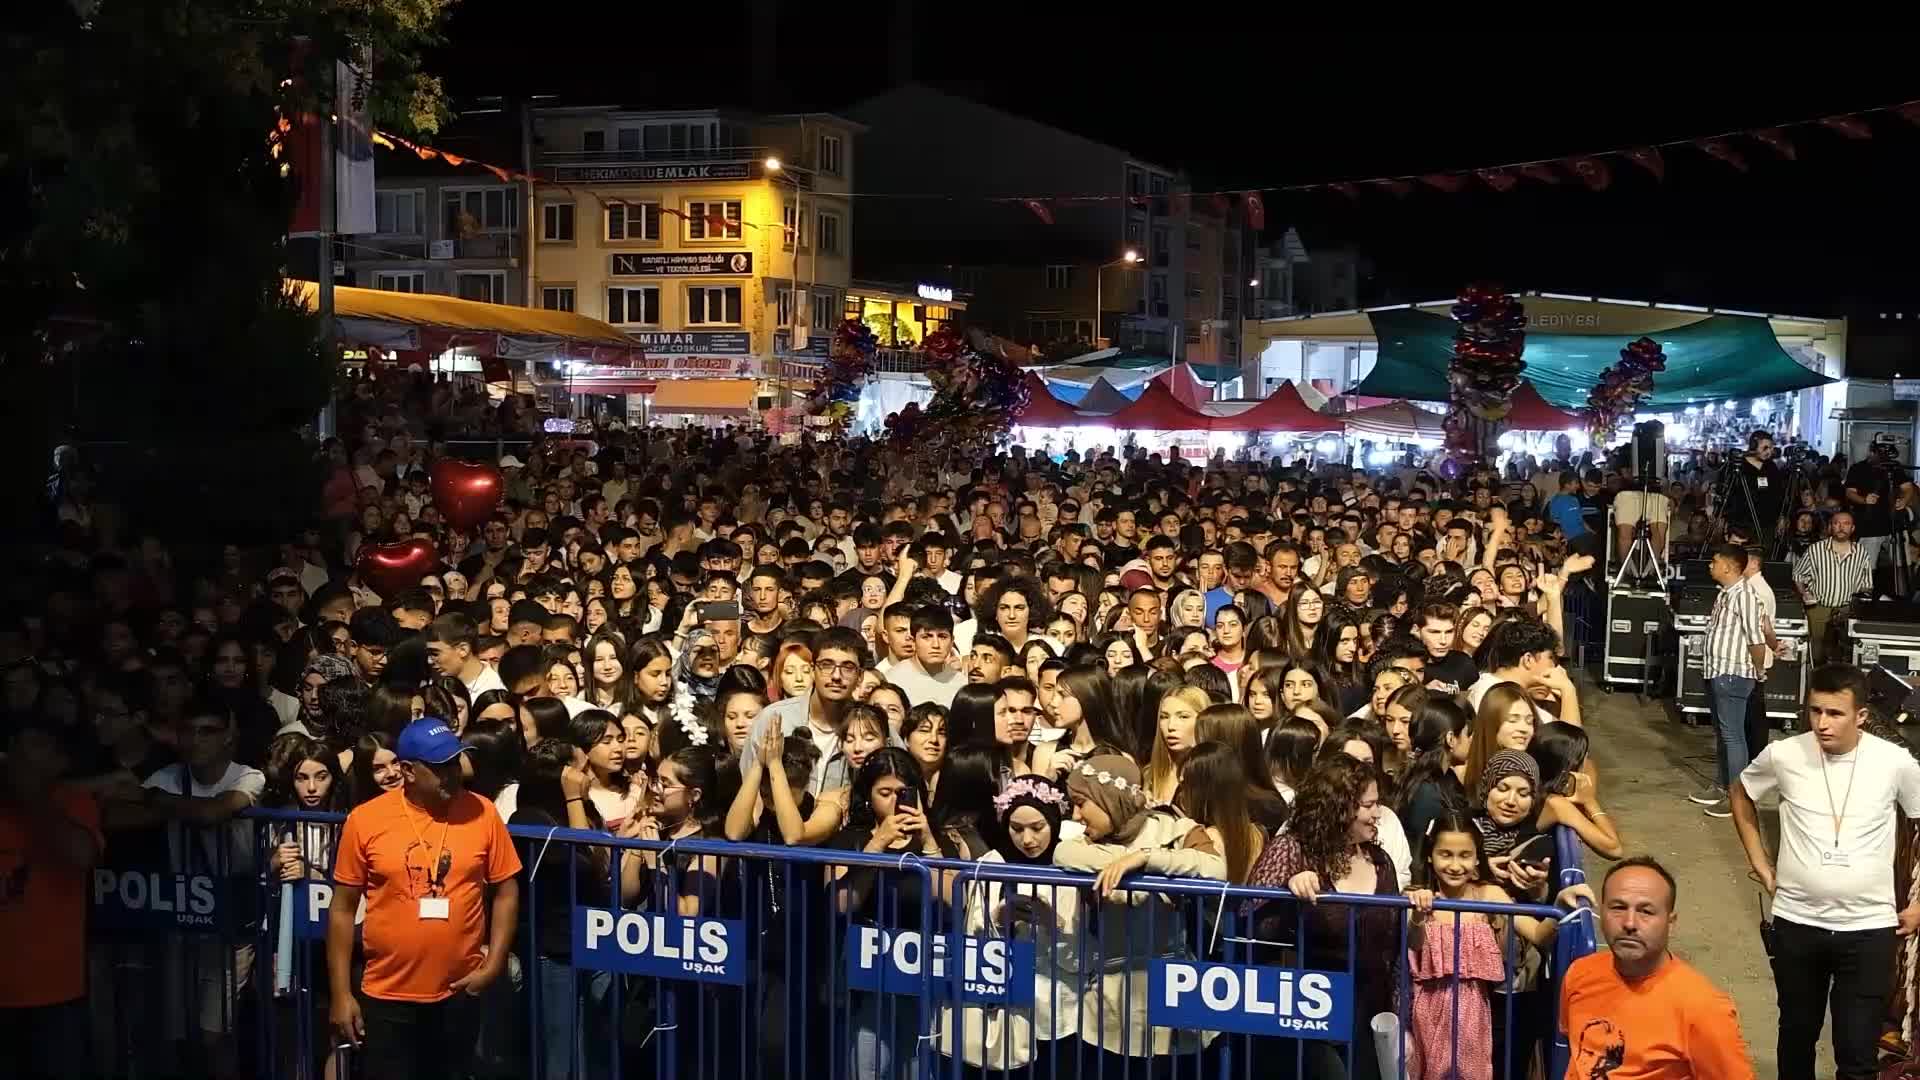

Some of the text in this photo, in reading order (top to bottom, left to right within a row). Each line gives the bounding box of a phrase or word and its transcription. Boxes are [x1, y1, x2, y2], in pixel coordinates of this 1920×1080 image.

[656, 165, 711, 178] EMLAK
[683, 961, 726, 974] UŞAK
[1279, 1018, 1329, 1031] UŞAK
